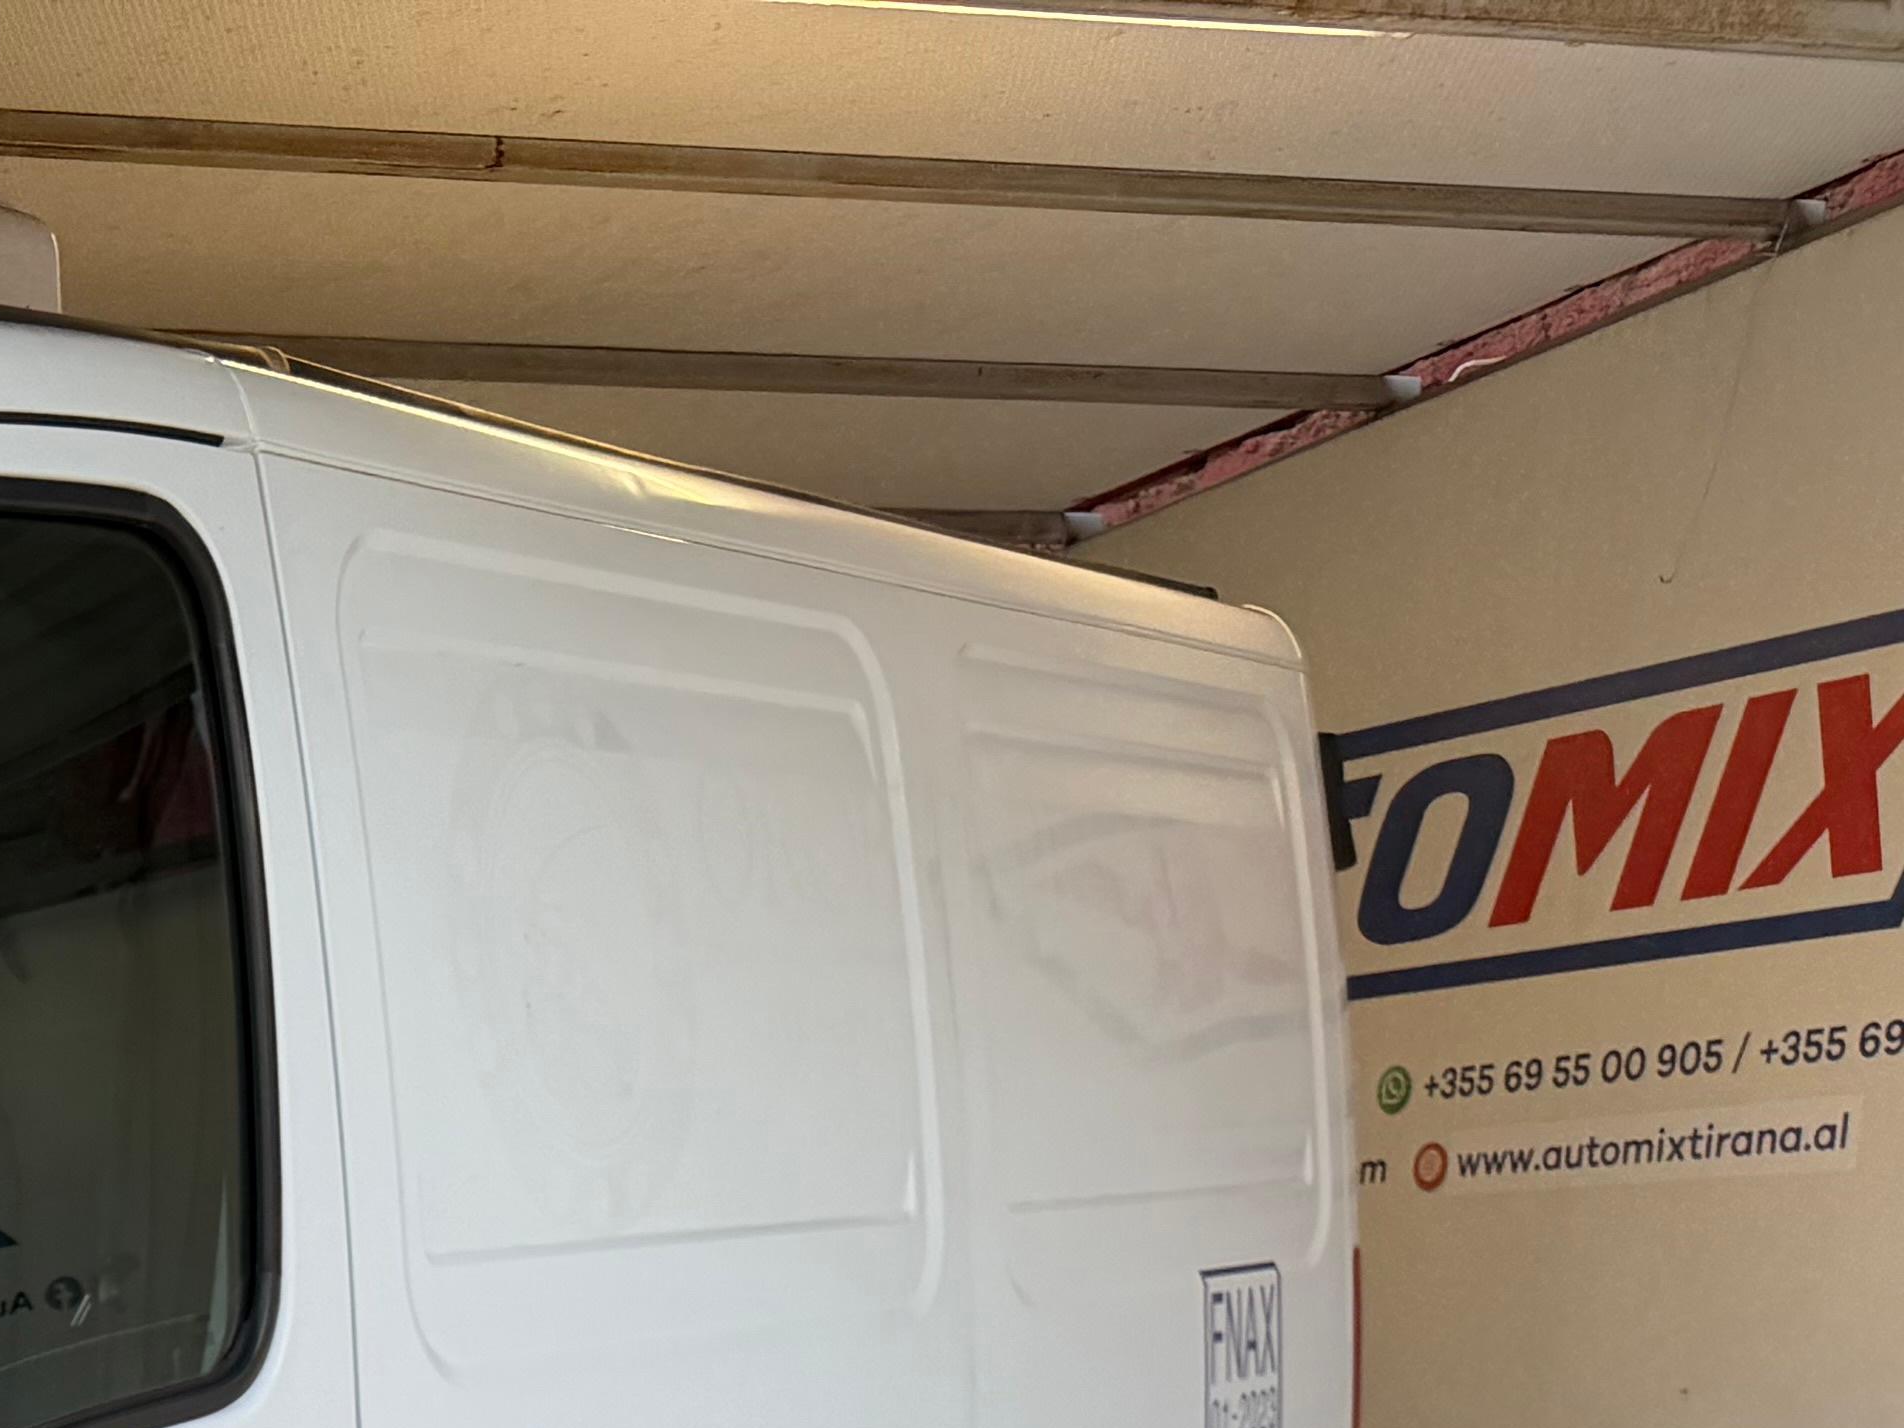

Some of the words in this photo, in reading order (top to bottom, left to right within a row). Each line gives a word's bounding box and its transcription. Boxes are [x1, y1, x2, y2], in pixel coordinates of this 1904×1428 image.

[1424, 1063, 1495, 1100] +355
[1504, 1058, 1543, 1093] 69
[1552, 1052, 1592, 1089] 55
[1600, 1046, 1646, 1084] 00
[1656, 1038, 1725, 1079] 905
[1760, 1024, 1848, 1067] +355
[1858, 1018, 1904, 1059] 69
[1457, 1111, 1850, 1177] www.automixtirana.al
[1210, 1283, 1277, 1386] FNAX
